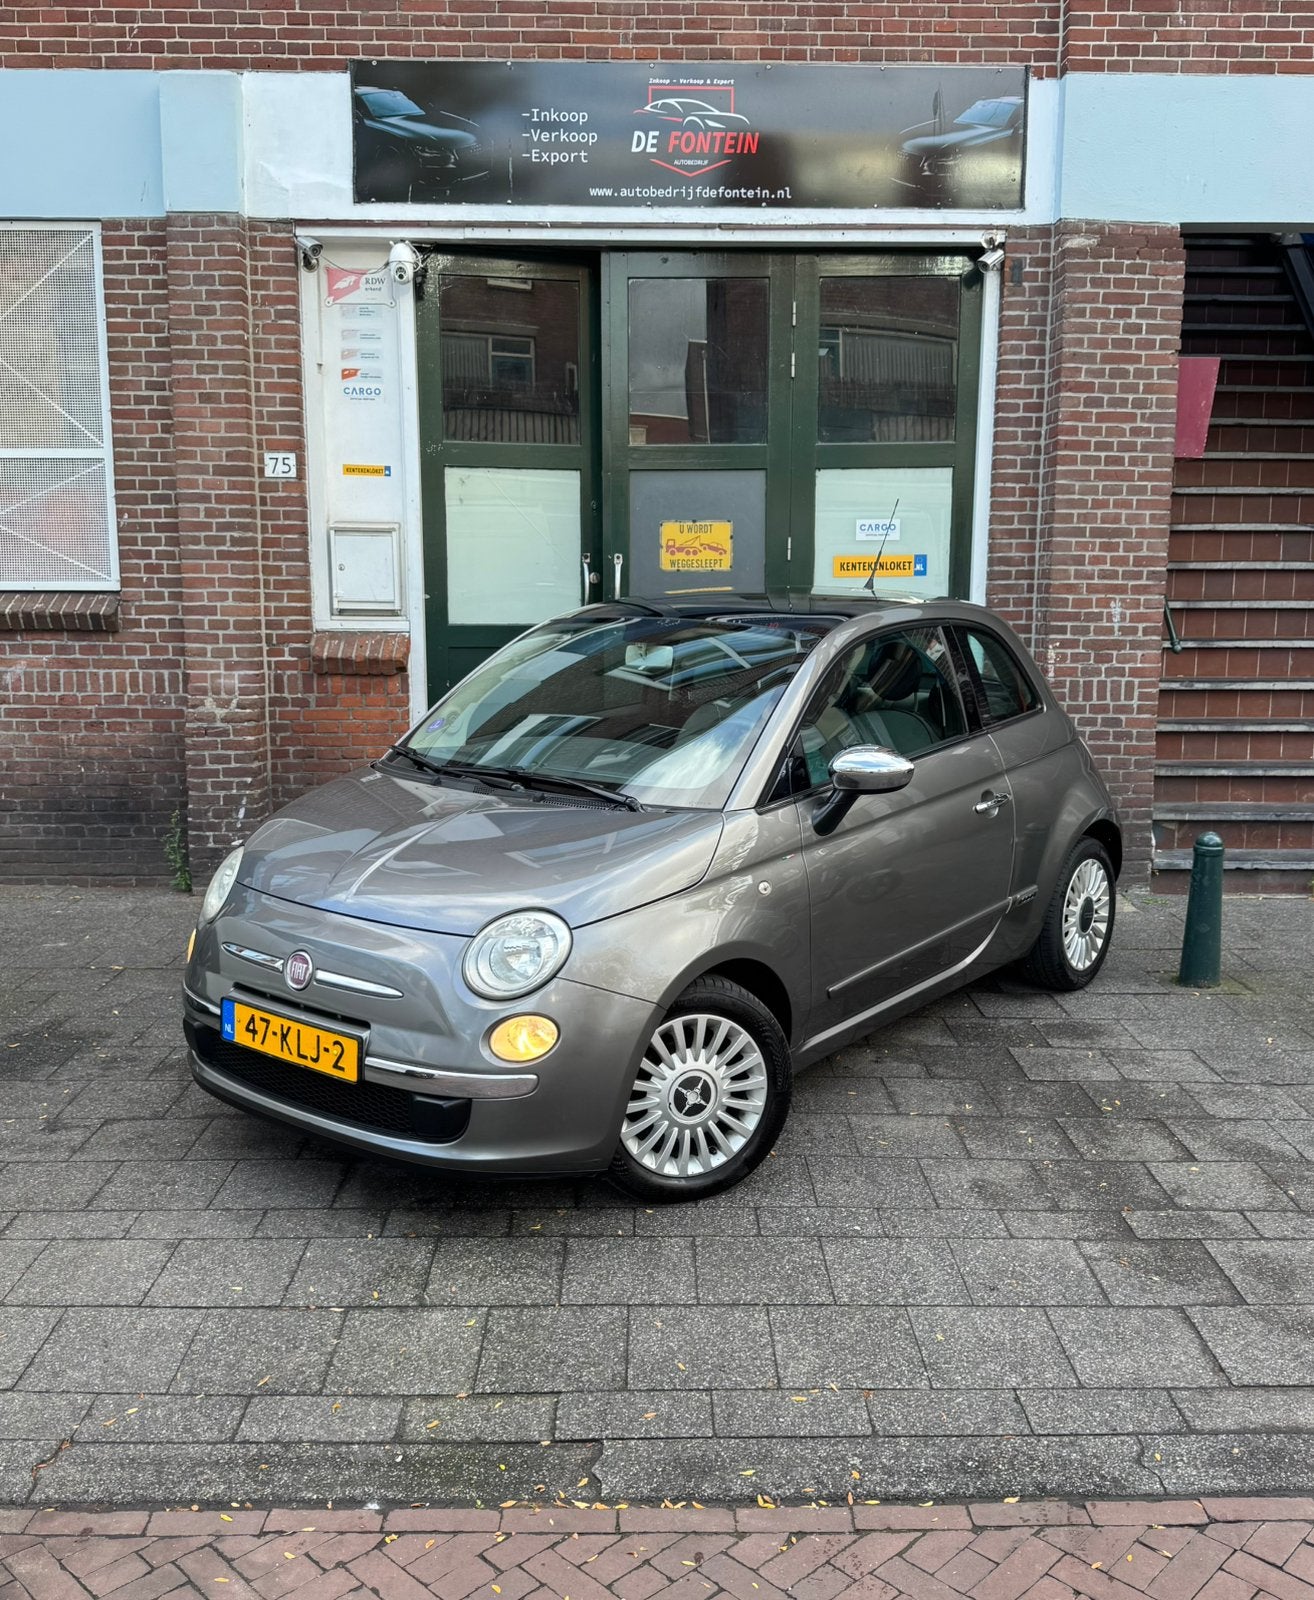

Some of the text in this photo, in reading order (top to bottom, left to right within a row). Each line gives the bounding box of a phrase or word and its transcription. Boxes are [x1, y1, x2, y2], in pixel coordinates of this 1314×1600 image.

[648, 77, 671, 85] Inkoop
[631, 130, 760, 154] DE FONTEIN
[589, 185, 792, 201] www.autobedrijfdefontein.nl
[364, 277, 386, 285] RDW
[343, 386, 382, 396] CARGO
[268, 457, 292, 475] 75
[679, 523, 714, 534] U WORDT
[859, 523, 897, 532] CARGO
[669, 558, 723, 569] WEGGESLEEPT
[291, 960, 308, 981] FIAT
[224, 1023, 234, 1034] NL
[244, 1013, 346, 1073] 47-KLJ-2
